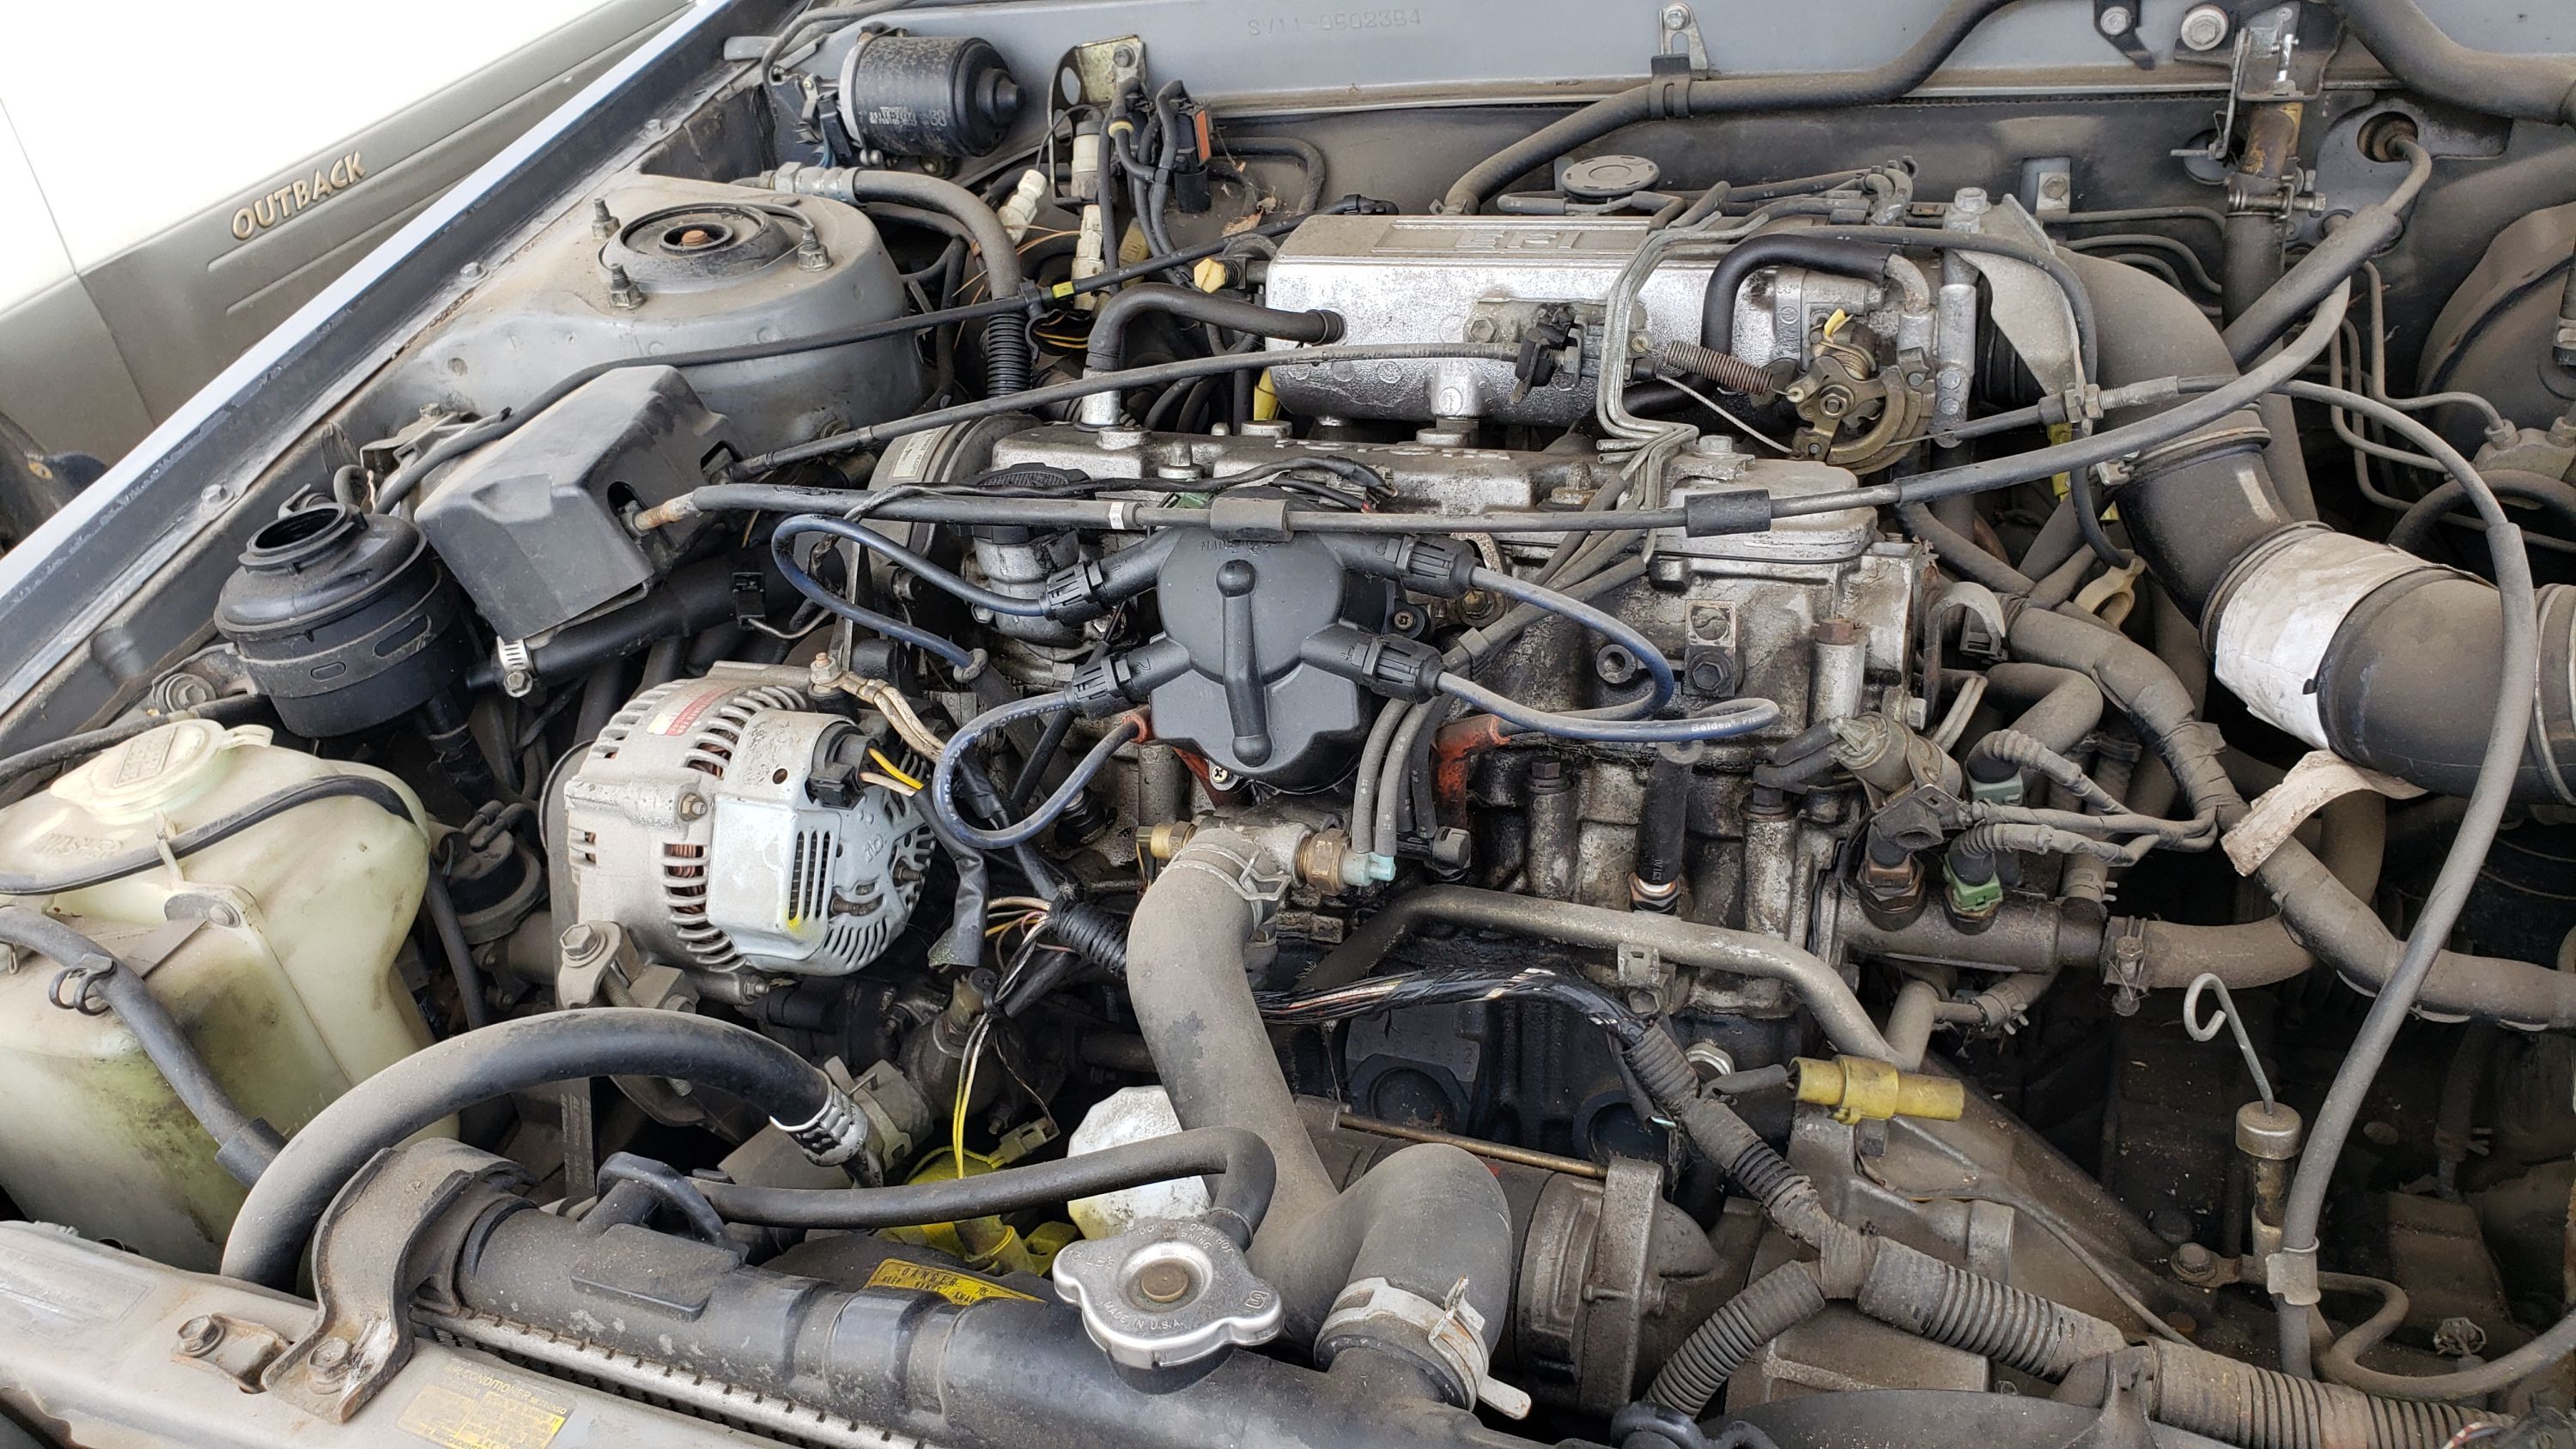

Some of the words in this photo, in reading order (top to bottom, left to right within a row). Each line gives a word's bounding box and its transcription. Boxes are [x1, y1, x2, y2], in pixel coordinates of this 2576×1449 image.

[232, 149, 366, 241] OUTBACK
[1455, 229, 1584, 250] EFI
[1691, 720, 1732, 732] Belden
[1139, 1224, 1154, 1235] DO
[1190, 1223, 1214, 1237] OPEN
[1215, 1234, 1235, 1253] HOT
[902, 1267, 958, 1286] DANGER
[1103, 1300, 1127, 1324] MADE
[1132, 1319, 1145, 1329] IN
